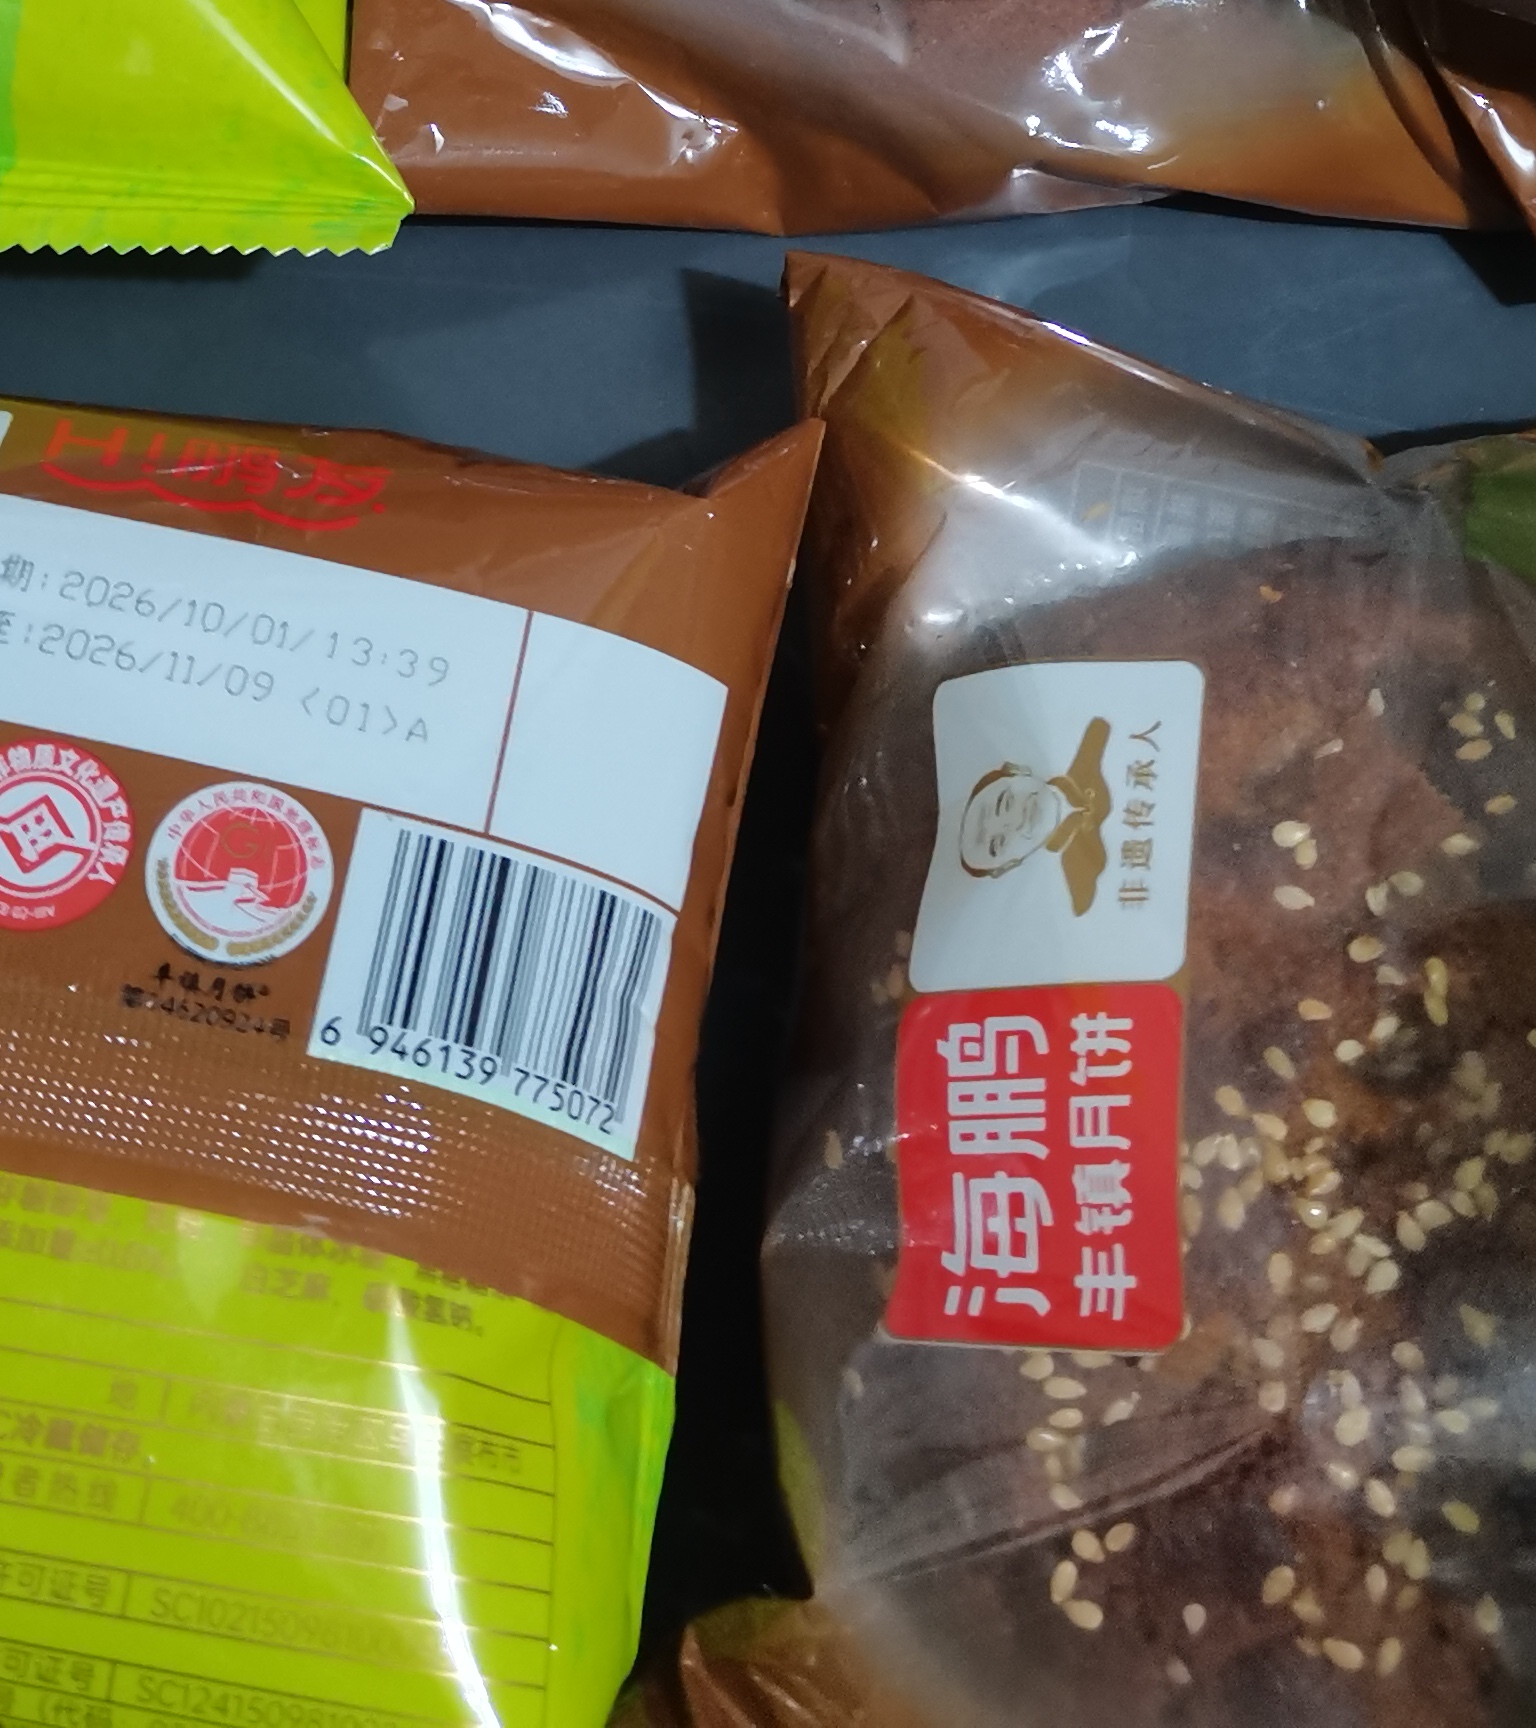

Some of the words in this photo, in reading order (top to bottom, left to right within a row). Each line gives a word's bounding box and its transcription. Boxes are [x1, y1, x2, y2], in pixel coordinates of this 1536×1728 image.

[1117, 717, 1164, 912] 非遗传承人
[319, 1016, 343, 1046] 6
[368, 1024, 500, 1086] 946139
[514, 1066, 617, 1136] 775072
[939, 1014, 1057, 1322] 海鹏
[1070, 1012, 1140, 1324] 丰镇月饼
